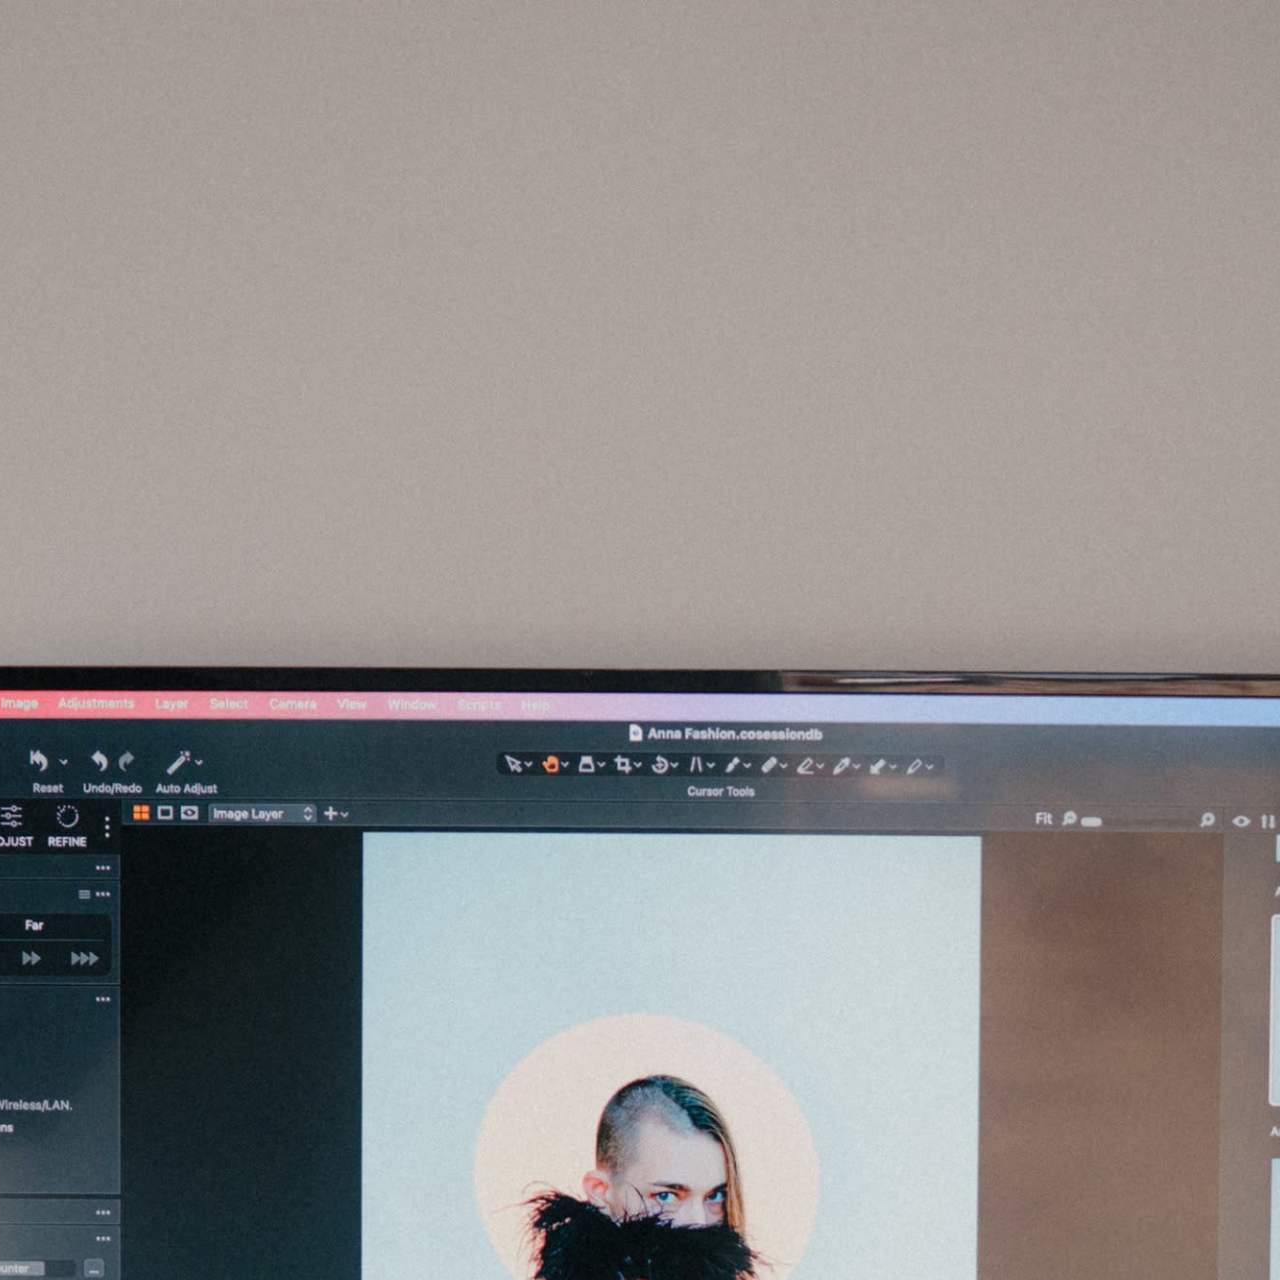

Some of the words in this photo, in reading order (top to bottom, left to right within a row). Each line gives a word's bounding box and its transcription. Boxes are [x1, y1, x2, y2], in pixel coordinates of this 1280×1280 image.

[1, 697, 39, 711] Image
[58, 697, 135, 711] Adjustments
[155, 698, 189, 711] Layer
[210, 698, 248, 709] Select
[270, 698, 317, 710] Camera
[337, 698, 367, 710] View
[387, 699, 437, 710] Window
[521, 699, 551, 712] Help
[648, 728, 682, 740] Anna
[685, 728, 823, 741] Fashion.cosessiondb
[33, 783, 64, 794] Reset
[83, 783, 143, 795] Undo/Redo
[156, 783, 181, 794] Auto
[184, 783, 218, 796] Adjust
[688, 786, 724, 797] Cursor
[728, 786, 756, 797] Tools
[213, 808, 249, 821] Image
[251, 808, 284, 822] Layer
[1035, 812, 1054, 826] Fit
[47, 836, 87, 847] REFINE
[25, 919, 44, 931] Far
